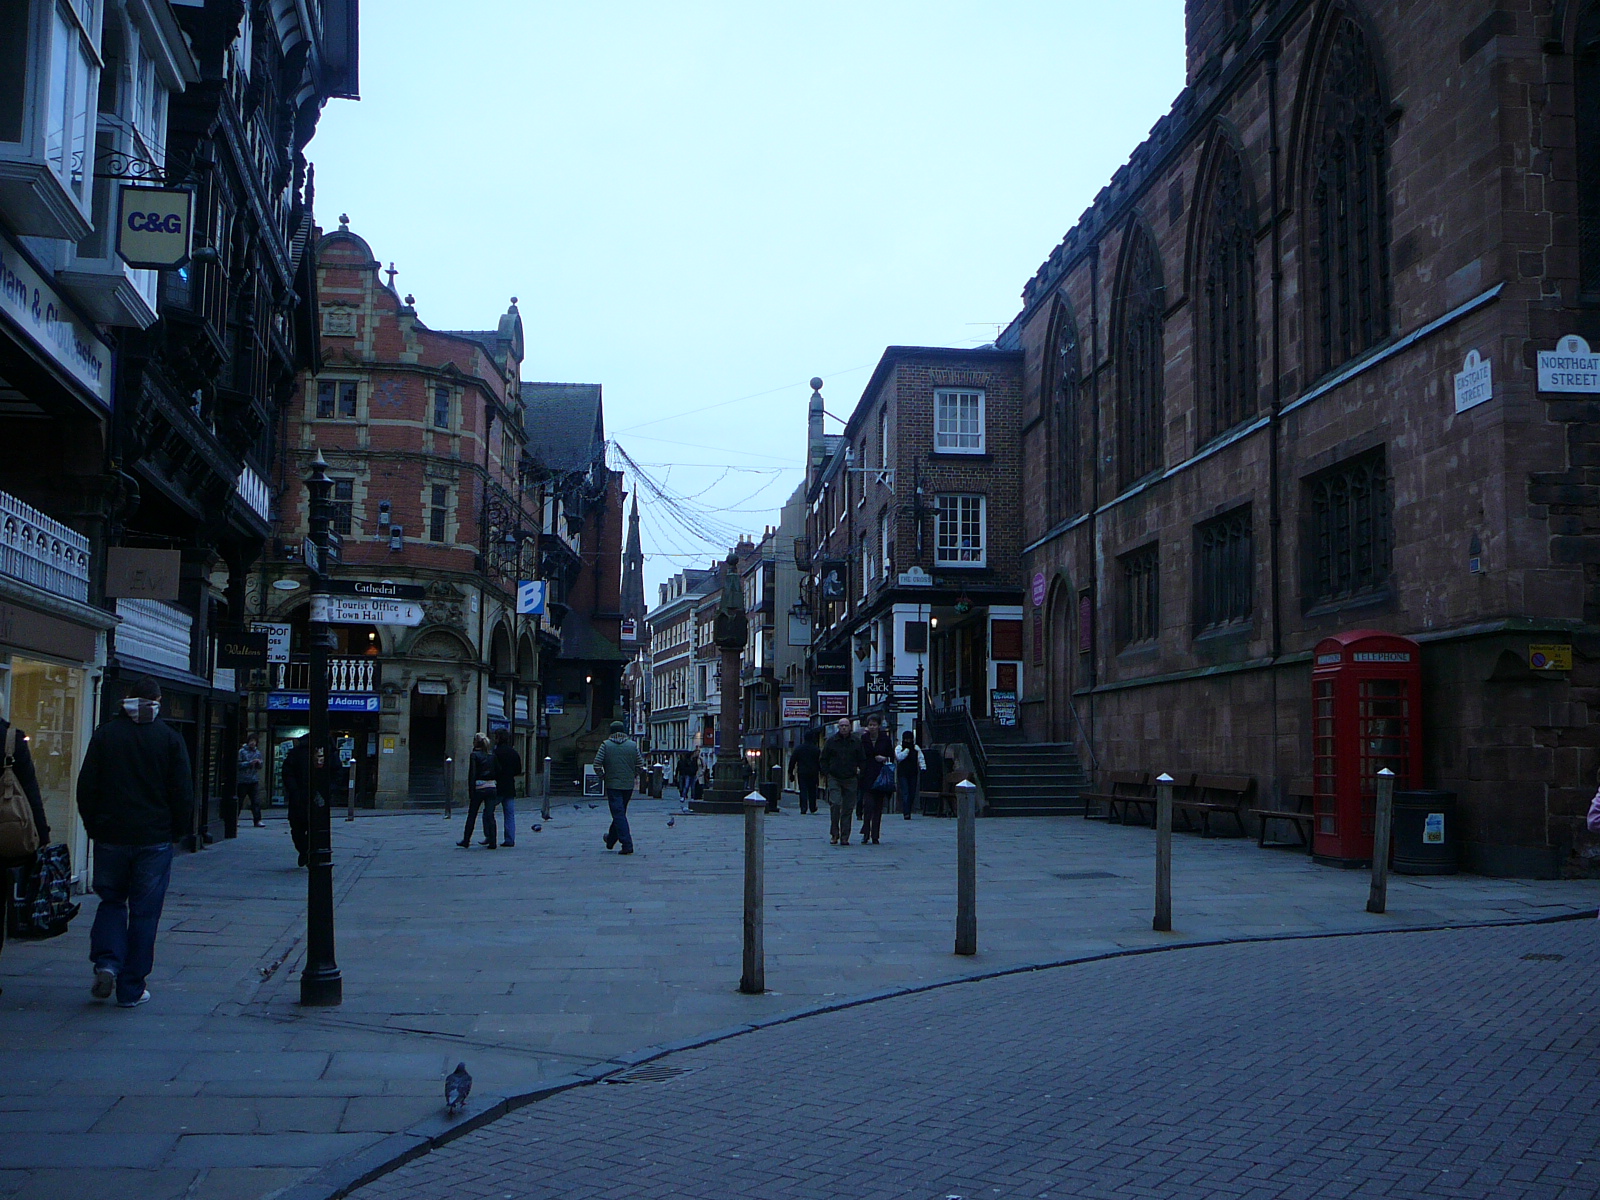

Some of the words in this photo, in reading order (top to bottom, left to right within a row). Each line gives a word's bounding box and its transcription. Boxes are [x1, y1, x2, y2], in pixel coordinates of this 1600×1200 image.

[128, 212, 182, 234] C&G
[31, 288, 42, 328] &
[46, 302, 103, 382] Gloucester
[1541, 357, 1599, 370] NORTHGAT
[1457, 366, 1489, 390] EASTGATE
[1551, 373, 1598, 386] STREET
[1461, 383, 1485, 404] STREET
[354, 582, 396, 595] Cathedral
[336, 599, 368, 610] Tourist
[372, 601, 399, 612] Office
[336, 609, 359, 619] Town
[362, 611, 383, 621] Hall
[1355, 652, 1408, 661] TELEPHONE
[866, 682, 889, 692] Rack
[335, 697, 366, 706] Adams
